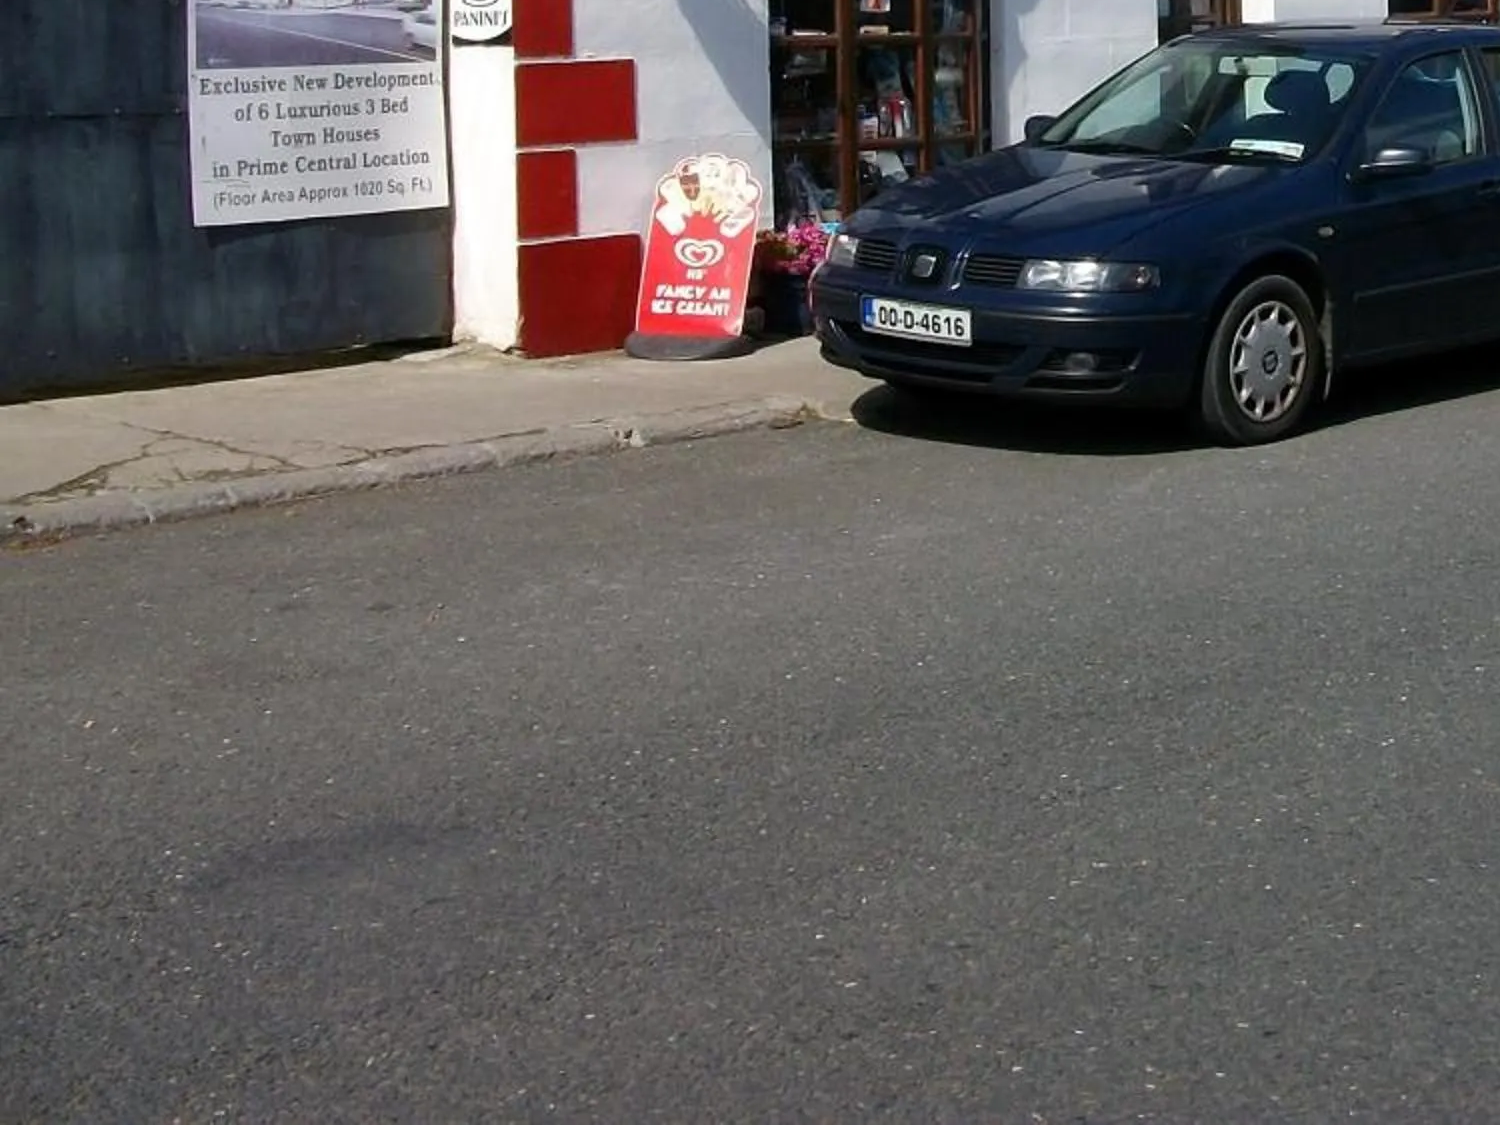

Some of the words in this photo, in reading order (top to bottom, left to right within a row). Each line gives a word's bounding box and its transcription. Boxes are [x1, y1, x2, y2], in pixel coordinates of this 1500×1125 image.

[199, 78, 287, 95] Exclusive
[293, 75, 328, 91] New
[334, 72, 434, 91] Development
[234, 103, 252, 121] of
[258, 104, 269, 119] 6
[276, 101, 360, 119] Luxurious
[365, 99, 375, 115] 3
[381, 97, 409, 114] Bed
[271, 130, 316, 147] Town
[323, 126, 380, 144] Houses
[212, 161, 229, 178] in
[237, 159, 289, 177] Prime
[295, 154, 357, 173] Central
[363, 150, 430, 168] Location
[213, 190, 257, 209] (Floor
[261, 188, 294, 203] Area
[297, 184, 348, 204] Approx
[354, 181, 383, 197] 1020
[656, 284, 707, 299] FANCY
[709, 286, 731, 300] AN
[652, 299, 674, 314] ICE
